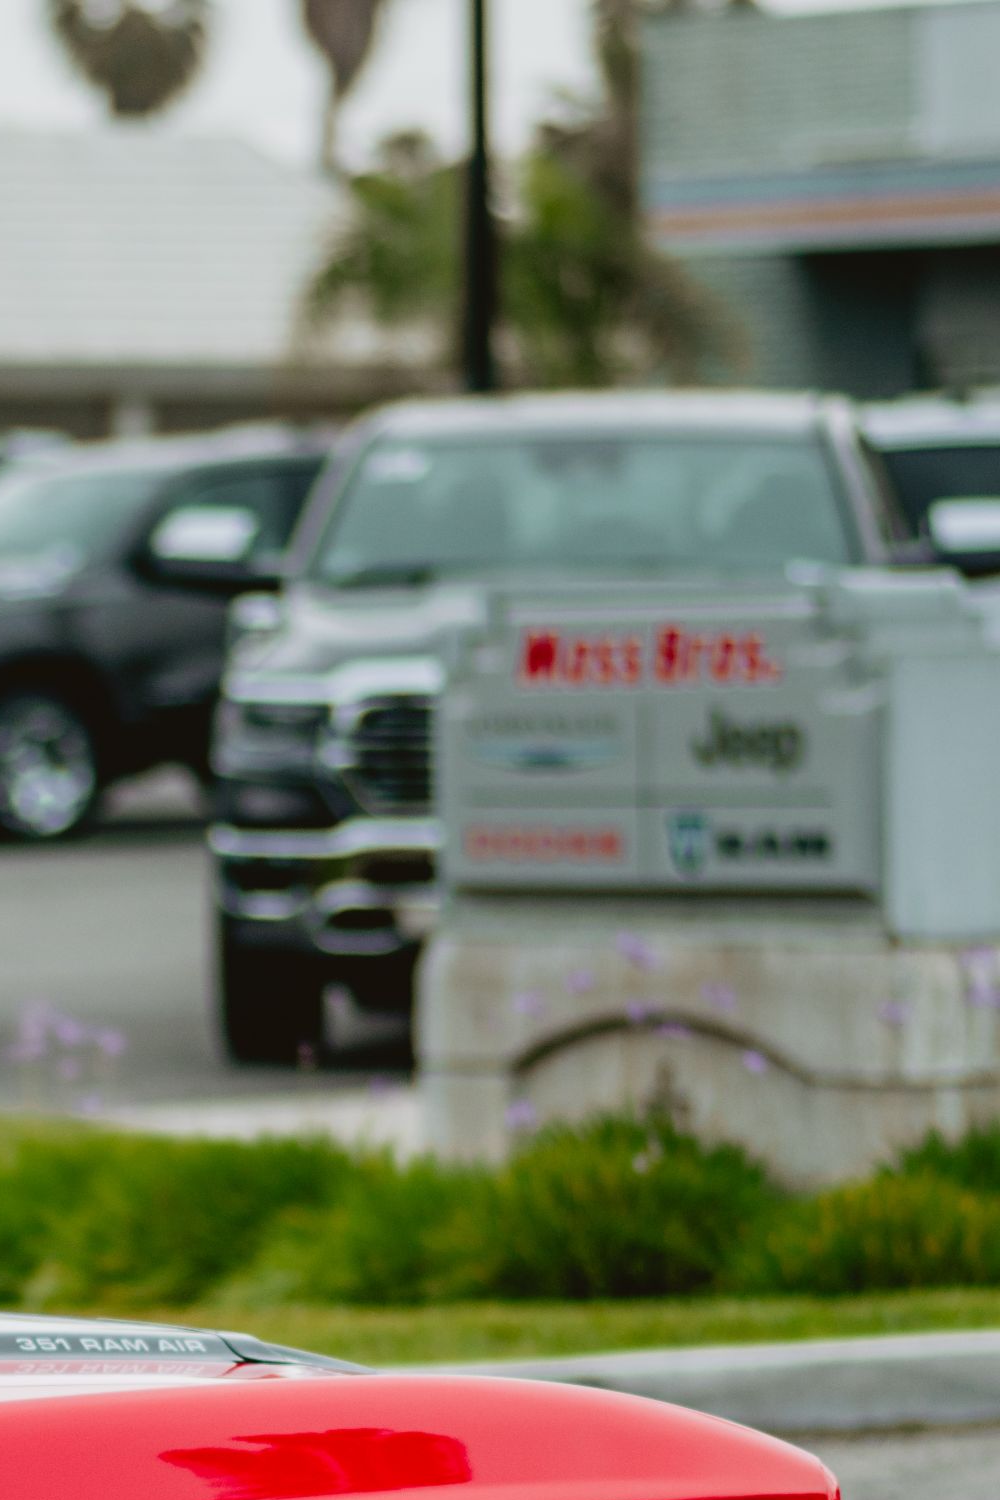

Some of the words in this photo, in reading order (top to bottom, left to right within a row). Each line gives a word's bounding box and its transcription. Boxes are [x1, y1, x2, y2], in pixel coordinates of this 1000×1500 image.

[694, 708, 806, 778] Jeep
[16, 1337, 72, 1351] 351
[79, 1337, 149, 1351] RAM
[157, 1338, 207, 1352] AIR
